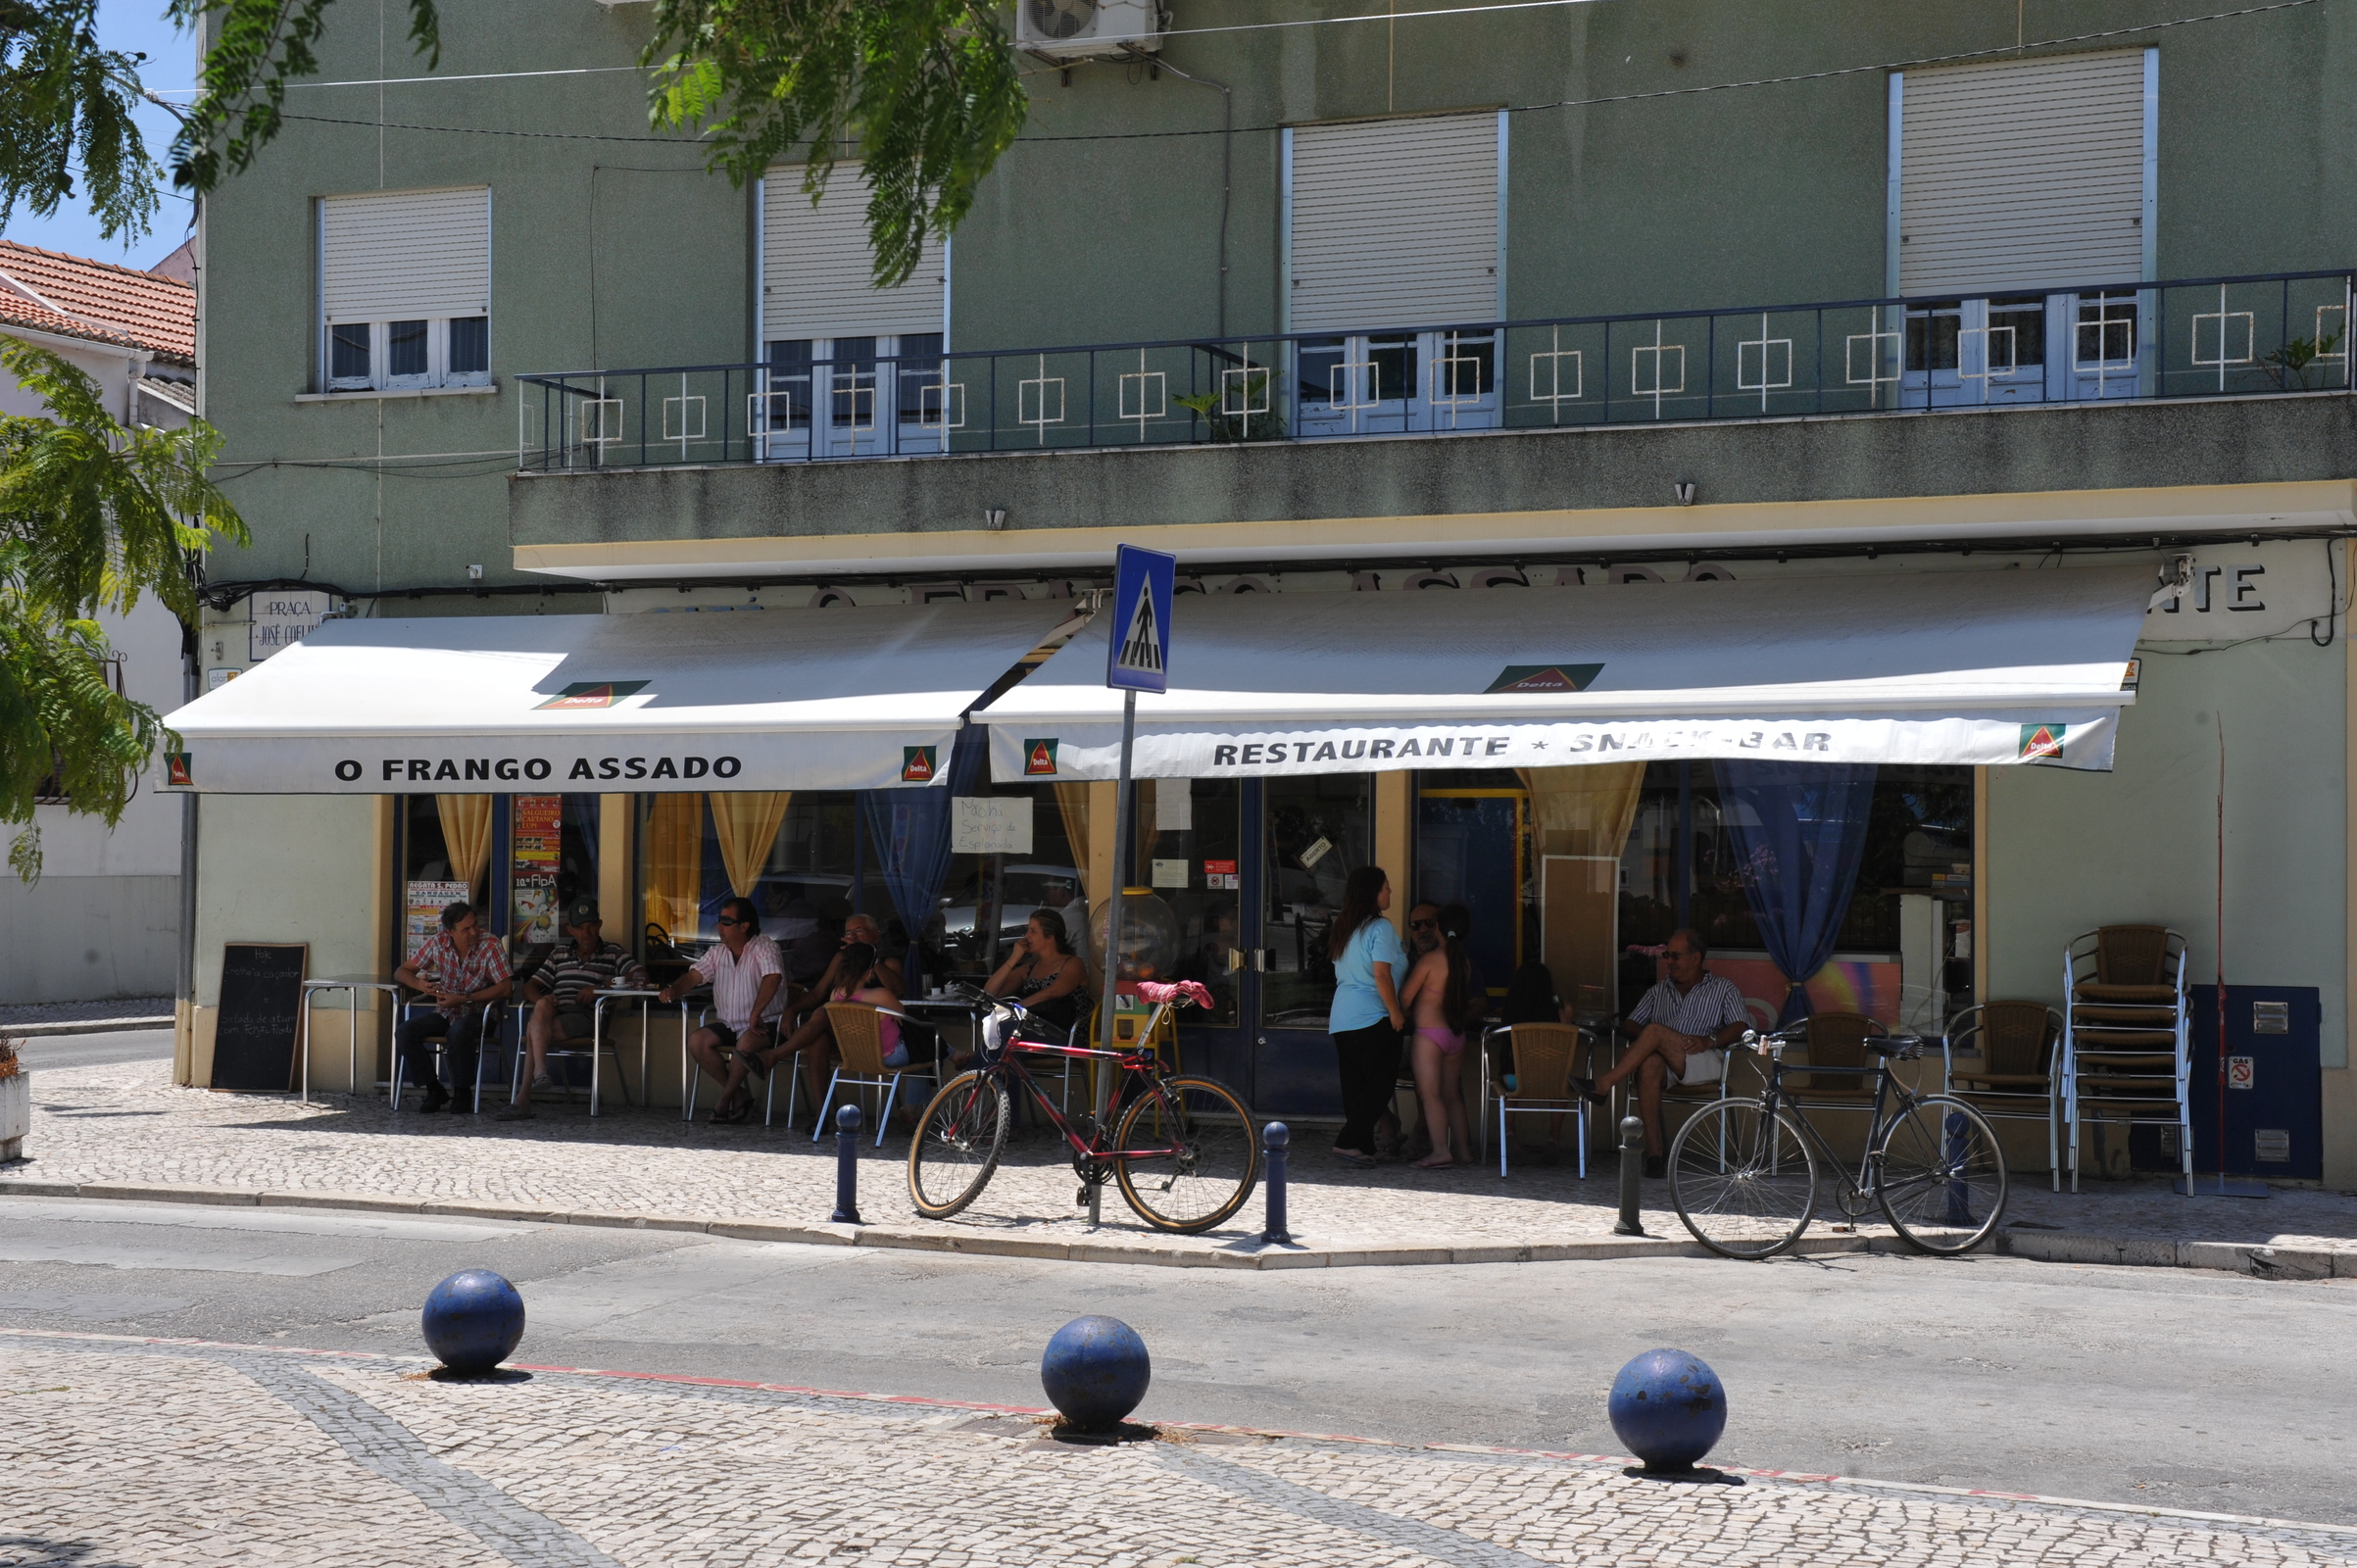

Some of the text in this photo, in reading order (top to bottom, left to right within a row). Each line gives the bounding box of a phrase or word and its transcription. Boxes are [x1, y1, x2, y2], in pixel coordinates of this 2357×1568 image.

[270, 602, 311, 616] PRAÇA
[1212, 736, 1510, 766] RESTAURANTE
[334, 756, 743, 782] O FRANGO ASSADO
[1033, 758, 1049, 766] Delta
[961, 798, 1004, 818] Não há
[961, 819, 1016, 834] Serviço de
[958, 836, 1013, 851] Esplanada
[1306, 842, 1326, 861] ABERTO
[255, 948, 271, 963] Hoje
